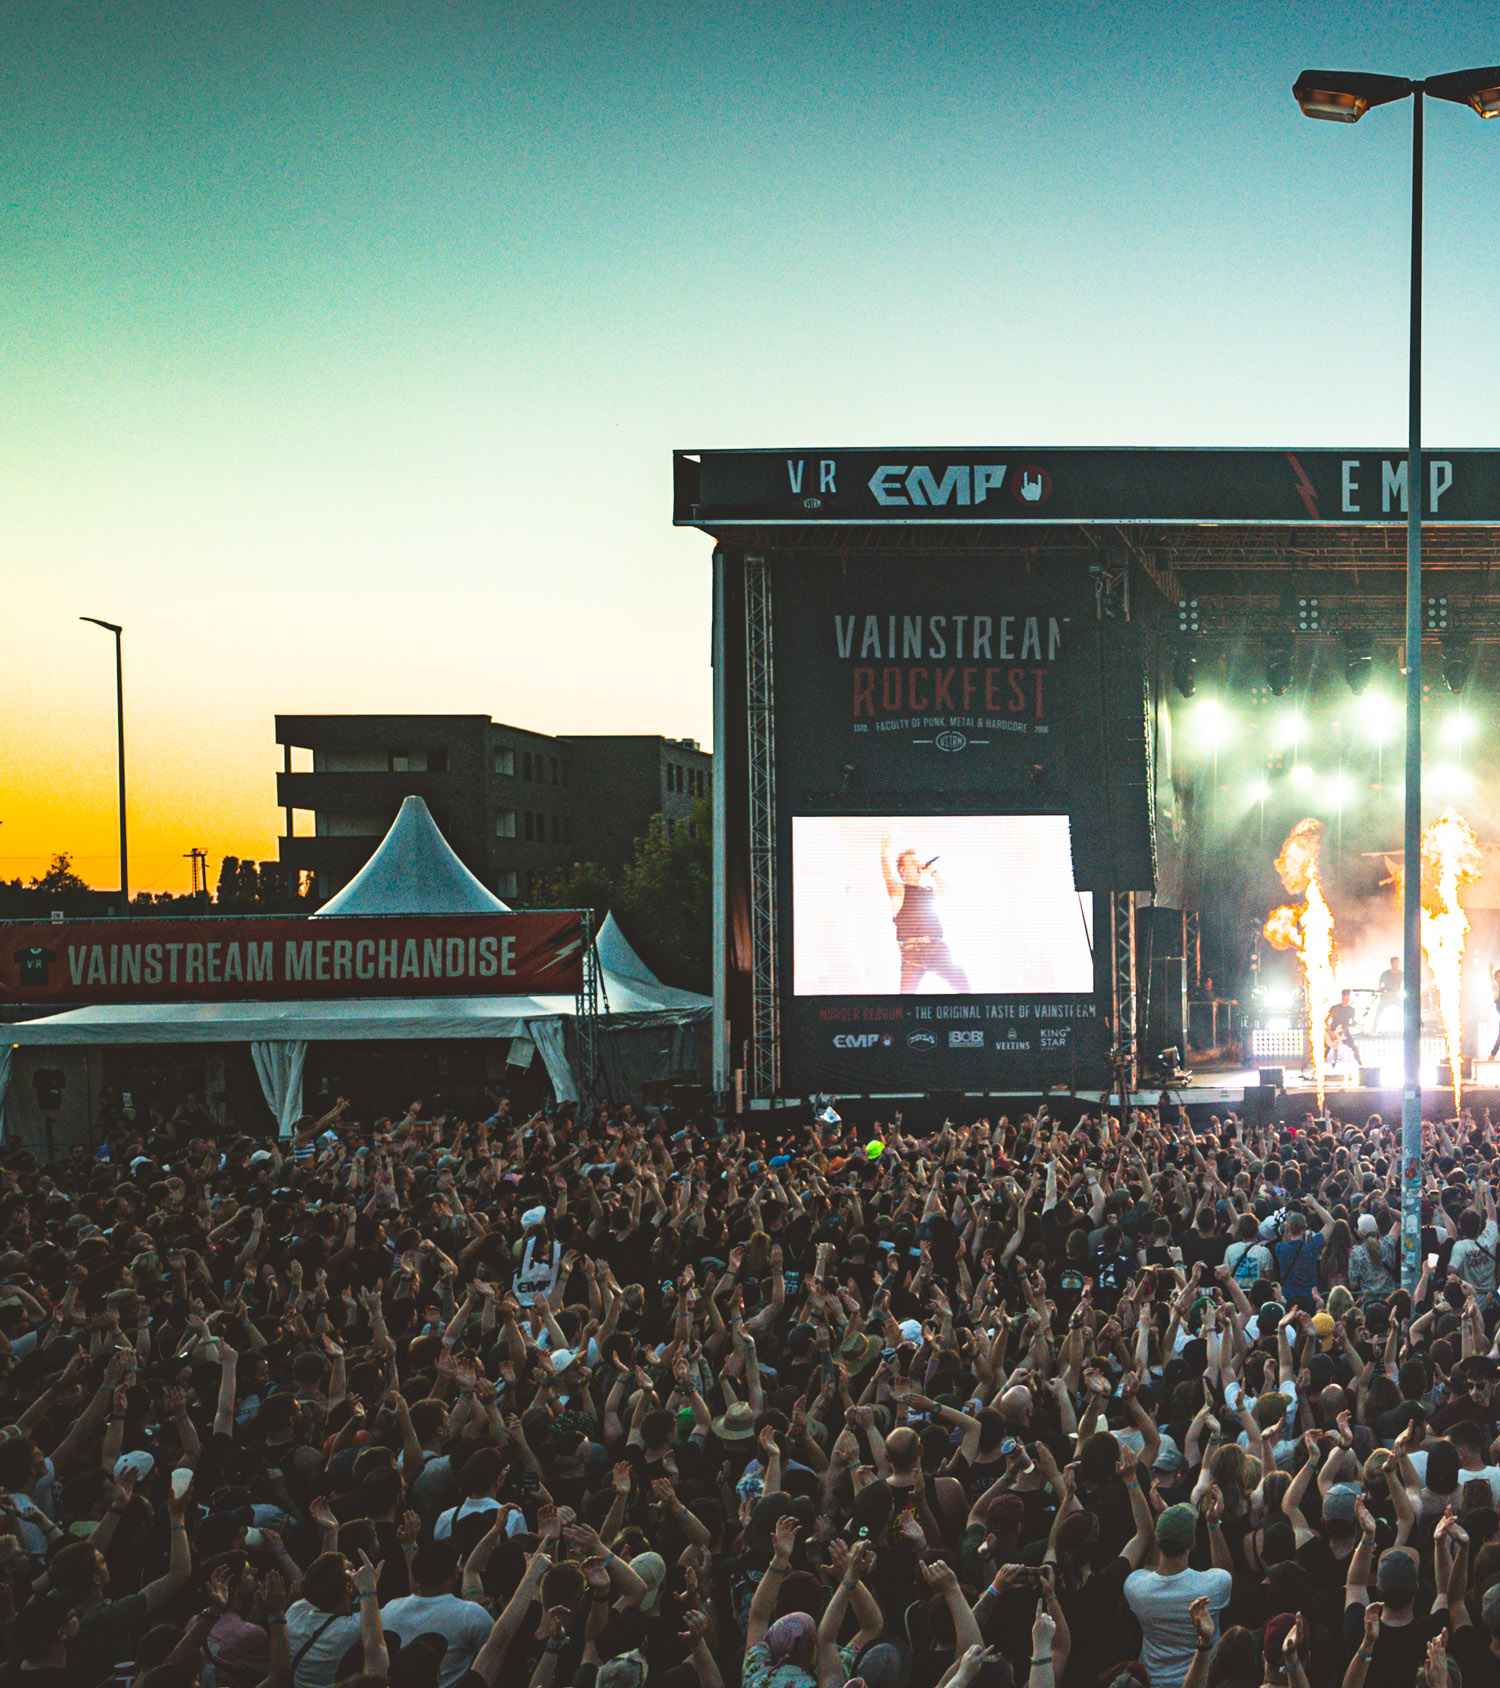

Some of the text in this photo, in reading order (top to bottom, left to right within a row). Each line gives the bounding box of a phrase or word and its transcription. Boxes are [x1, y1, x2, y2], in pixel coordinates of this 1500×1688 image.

[868, 465, 1007, 506] EMP
[1341, 460, 1453, 513] EMP
[852, 667, 1048, 720] ROCKFEST
[68, 935, 517, 985] VAINSTREAM MERCHANDISE
[915, 1006, 932, 1020] THE
[936, 1005, 981, 1019] ORIGINAL
[985, 1005, 1017, 1019] TASTE
[1019, 1005, 1032, 1018] OF
[1040, 1029, 1067, 1038] KING
[1040, 1038, 1066, 1047] STAR
